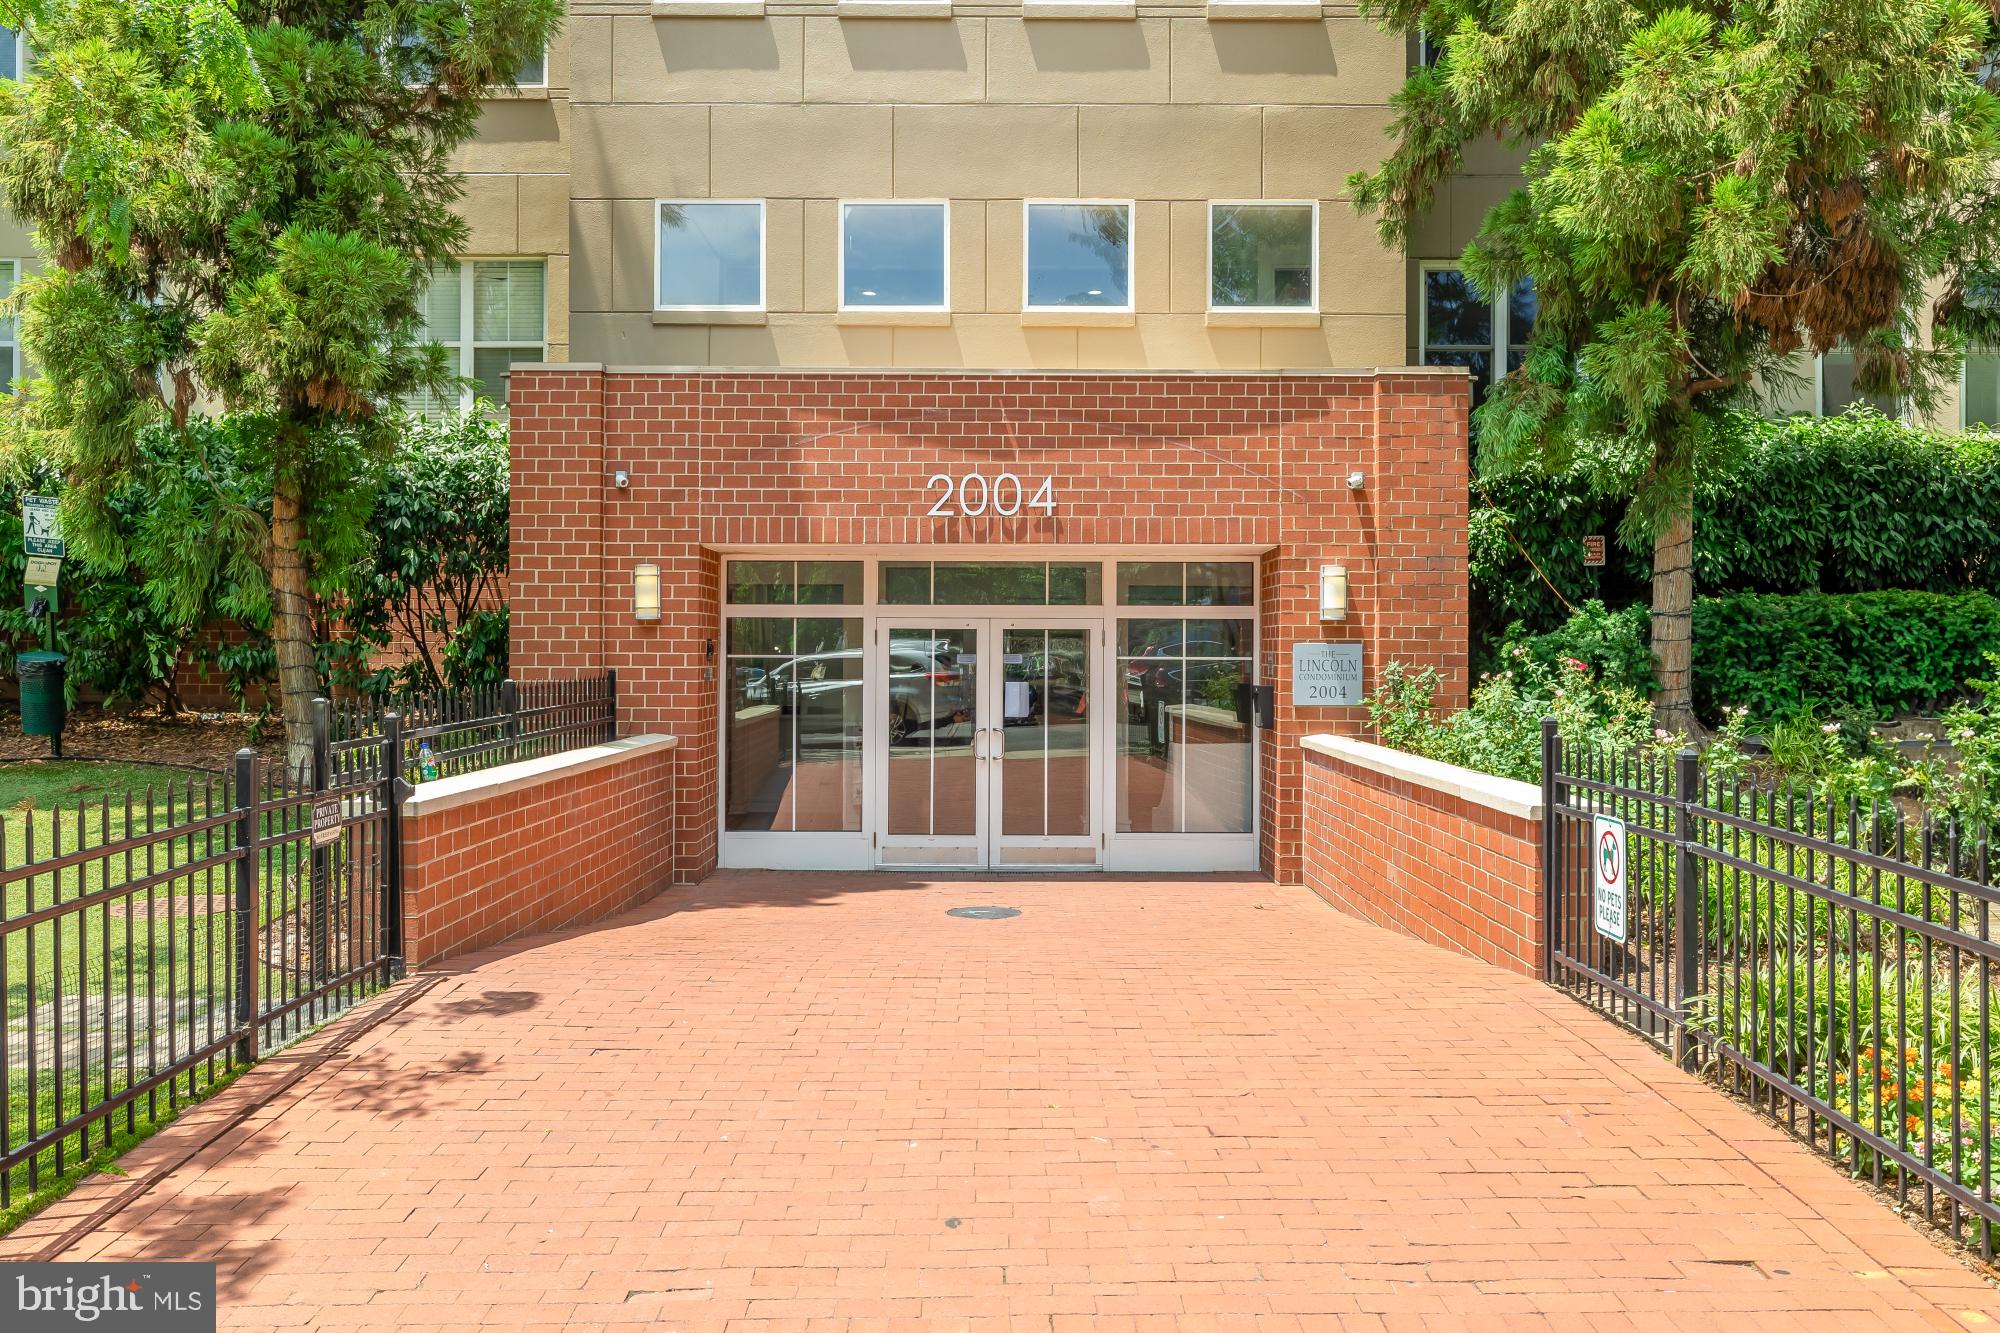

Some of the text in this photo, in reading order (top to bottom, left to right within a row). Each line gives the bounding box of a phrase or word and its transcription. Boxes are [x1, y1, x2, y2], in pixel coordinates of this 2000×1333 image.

[926, 472, 1057, 516] 2004
[1320, 650, 1336, 658] THE
[1299, 659, 1358, 672] LINCOLN
[1298, 673, 1358, 681] CONDOMINIUM
[1309, 685, 1348, 699] 2004
[316, 803, 339, 818] PRIVATE
[314, 813, 340, 830] PROPERTY
[1598, 888, 1622, 910] NO PETS
[1599, 904, 1620, 926] PLEASE
